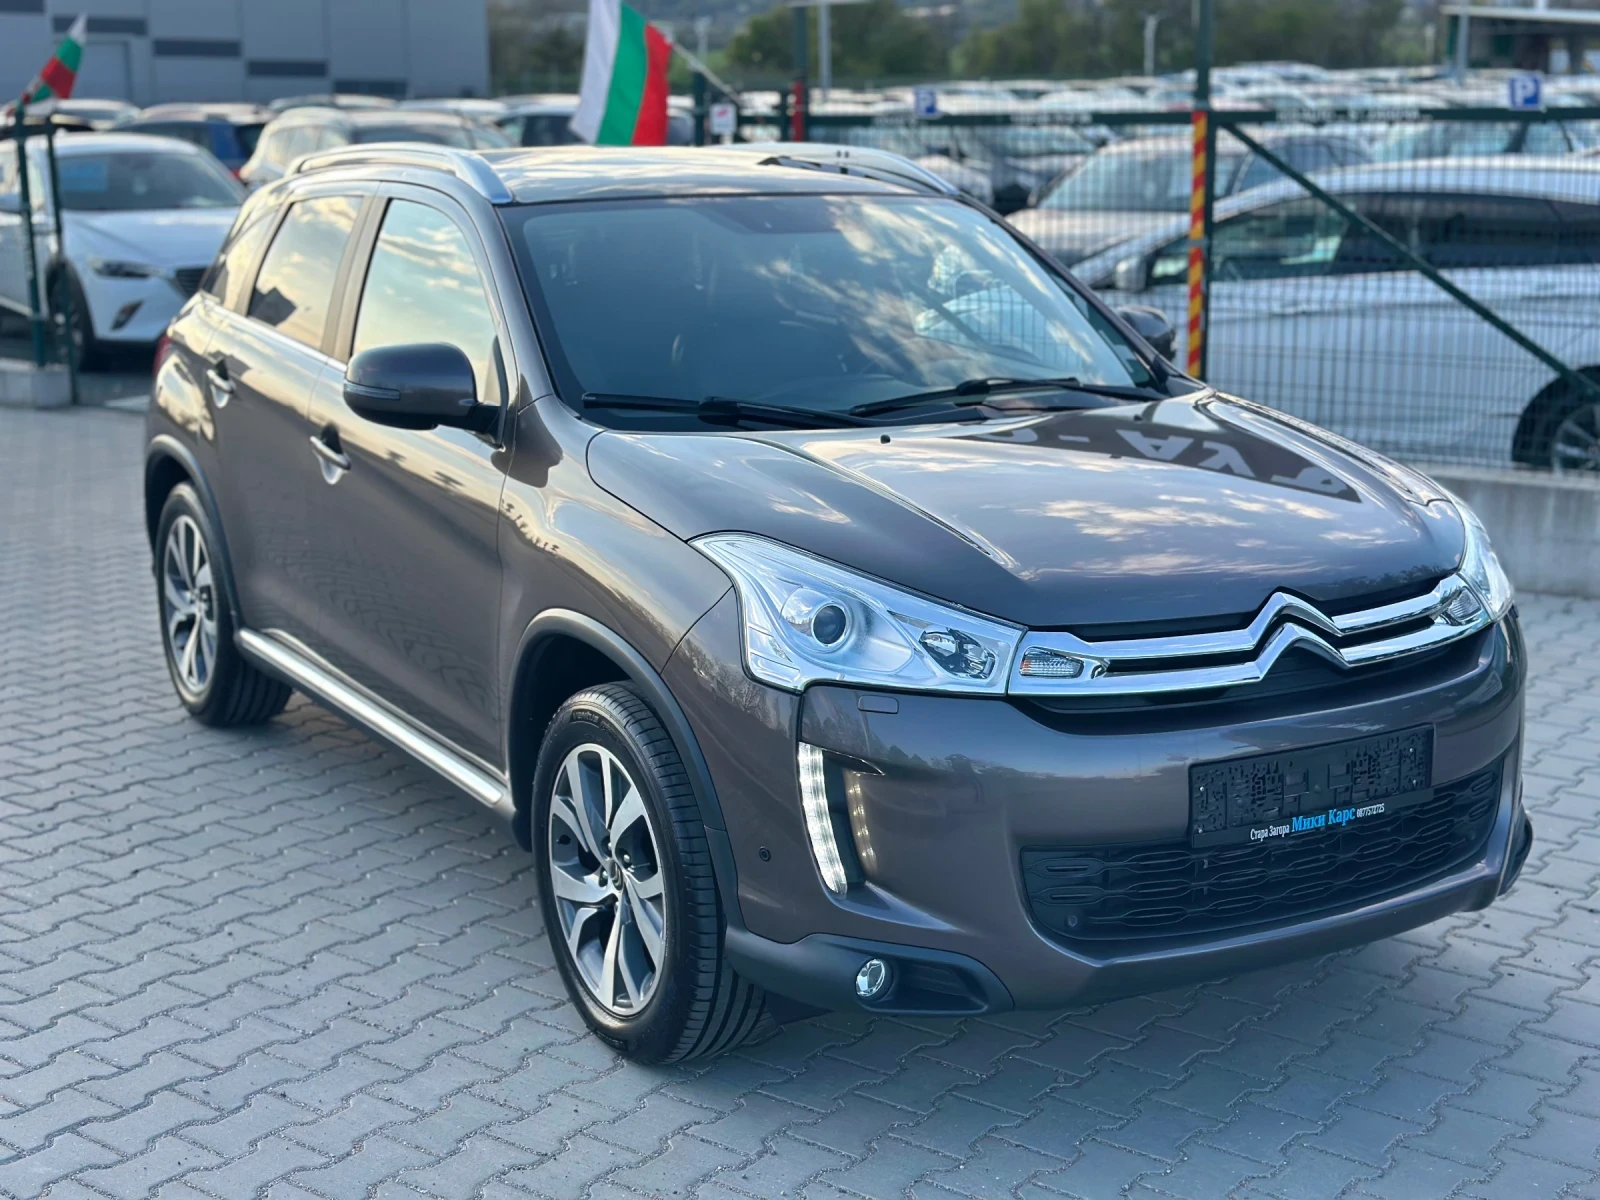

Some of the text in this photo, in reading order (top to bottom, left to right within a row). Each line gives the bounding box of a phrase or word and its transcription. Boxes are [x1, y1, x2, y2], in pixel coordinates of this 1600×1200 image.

[1250, 829, 1269, 842] Стара
[1269, 824, 1290, 838] Загора
[1291, 814, 1326, 832] Мики
[1328, 807, 1356, 826] Карс
